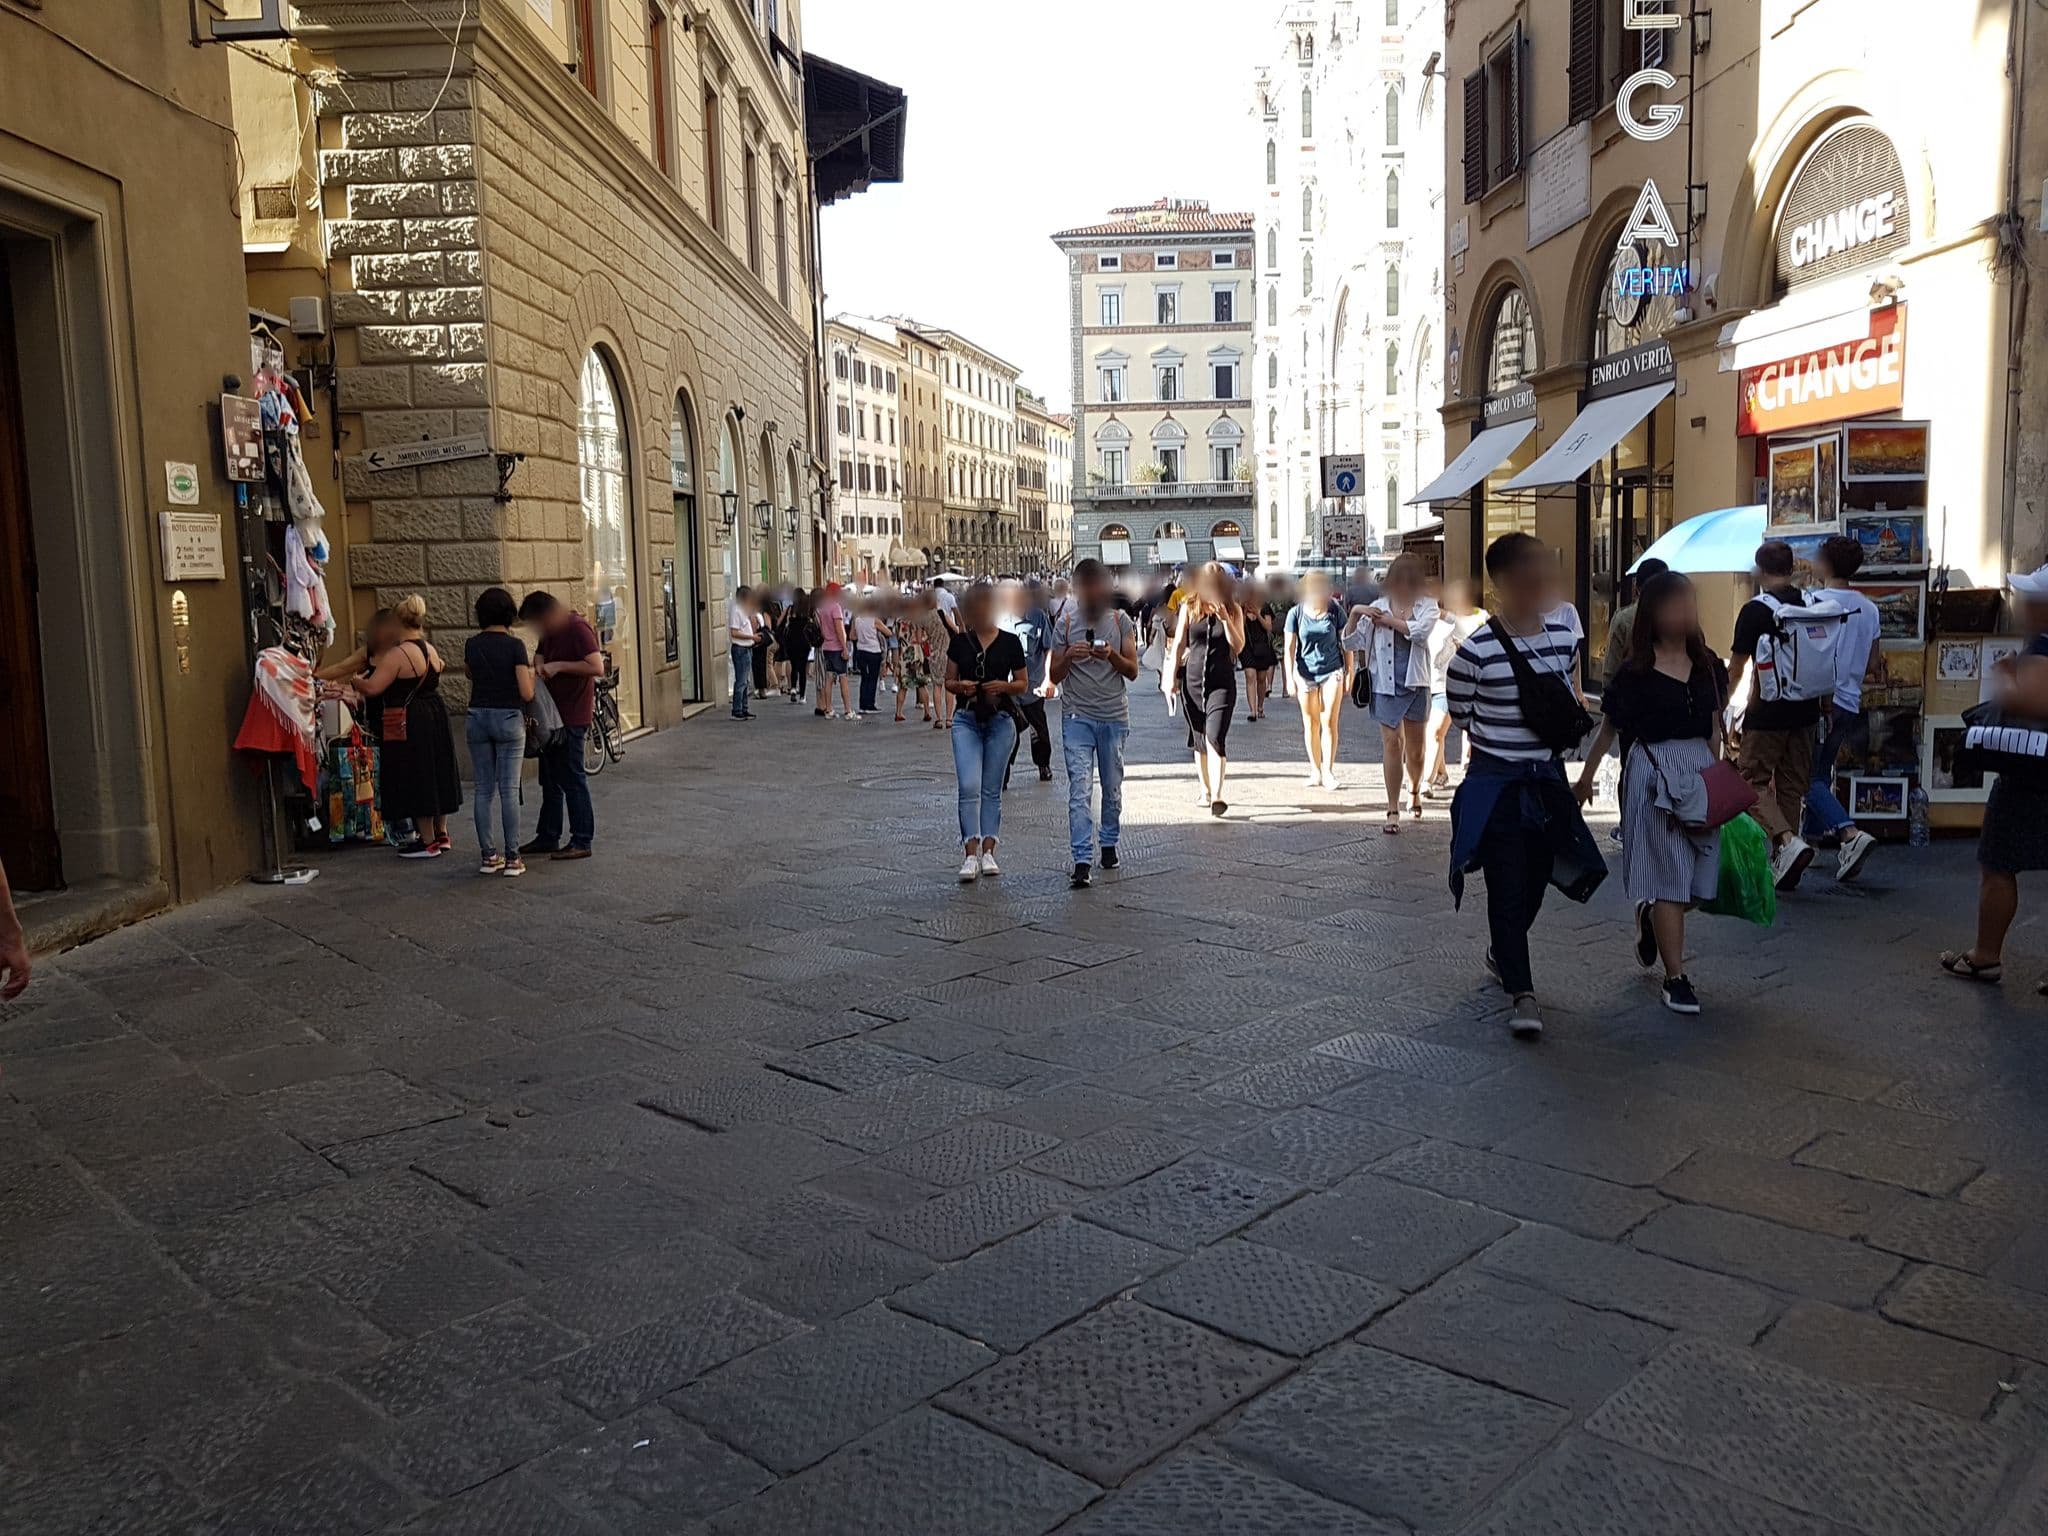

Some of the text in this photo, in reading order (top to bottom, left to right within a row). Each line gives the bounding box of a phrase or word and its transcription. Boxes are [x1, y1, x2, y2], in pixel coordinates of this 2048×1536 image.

[1790, 190, 1897, 268] CHANGE
[1592, 358, 1631, 387] ENRICO
[1757, 332, 1900, 411] CHANGE
[1484, 396, 1510, 418] ENRICO
[442, 444, 467, 454] MEDICI
[171, 524, 187, 532] HOTEL
[1965, 725, 2048, 757] PUMA
